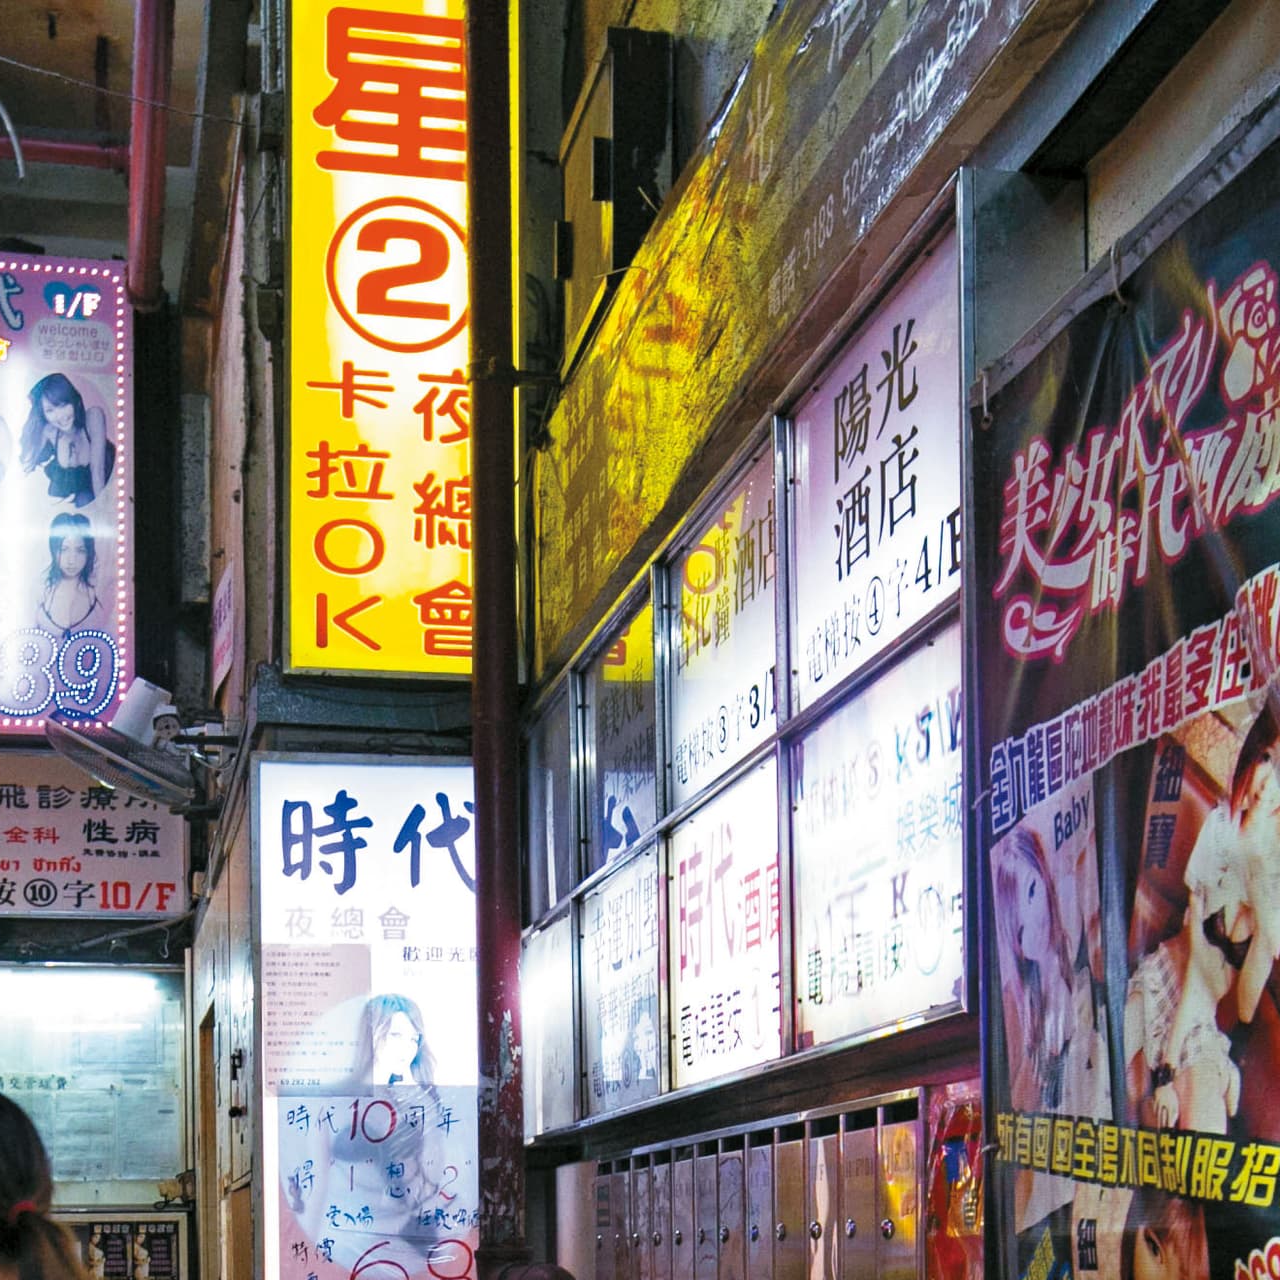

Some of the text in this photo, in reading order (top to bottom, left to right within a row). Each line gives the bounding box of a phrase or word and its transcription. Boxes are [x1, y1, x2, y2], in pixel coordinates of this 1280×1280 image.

[3, 825, 60, 845] 全科
[82, 818, 160, 846] 性病
[1054, 790, 1091, 851] Baby
[281, 789, 477, 897] 時代
[100, 881, 176, 910] 10/F
